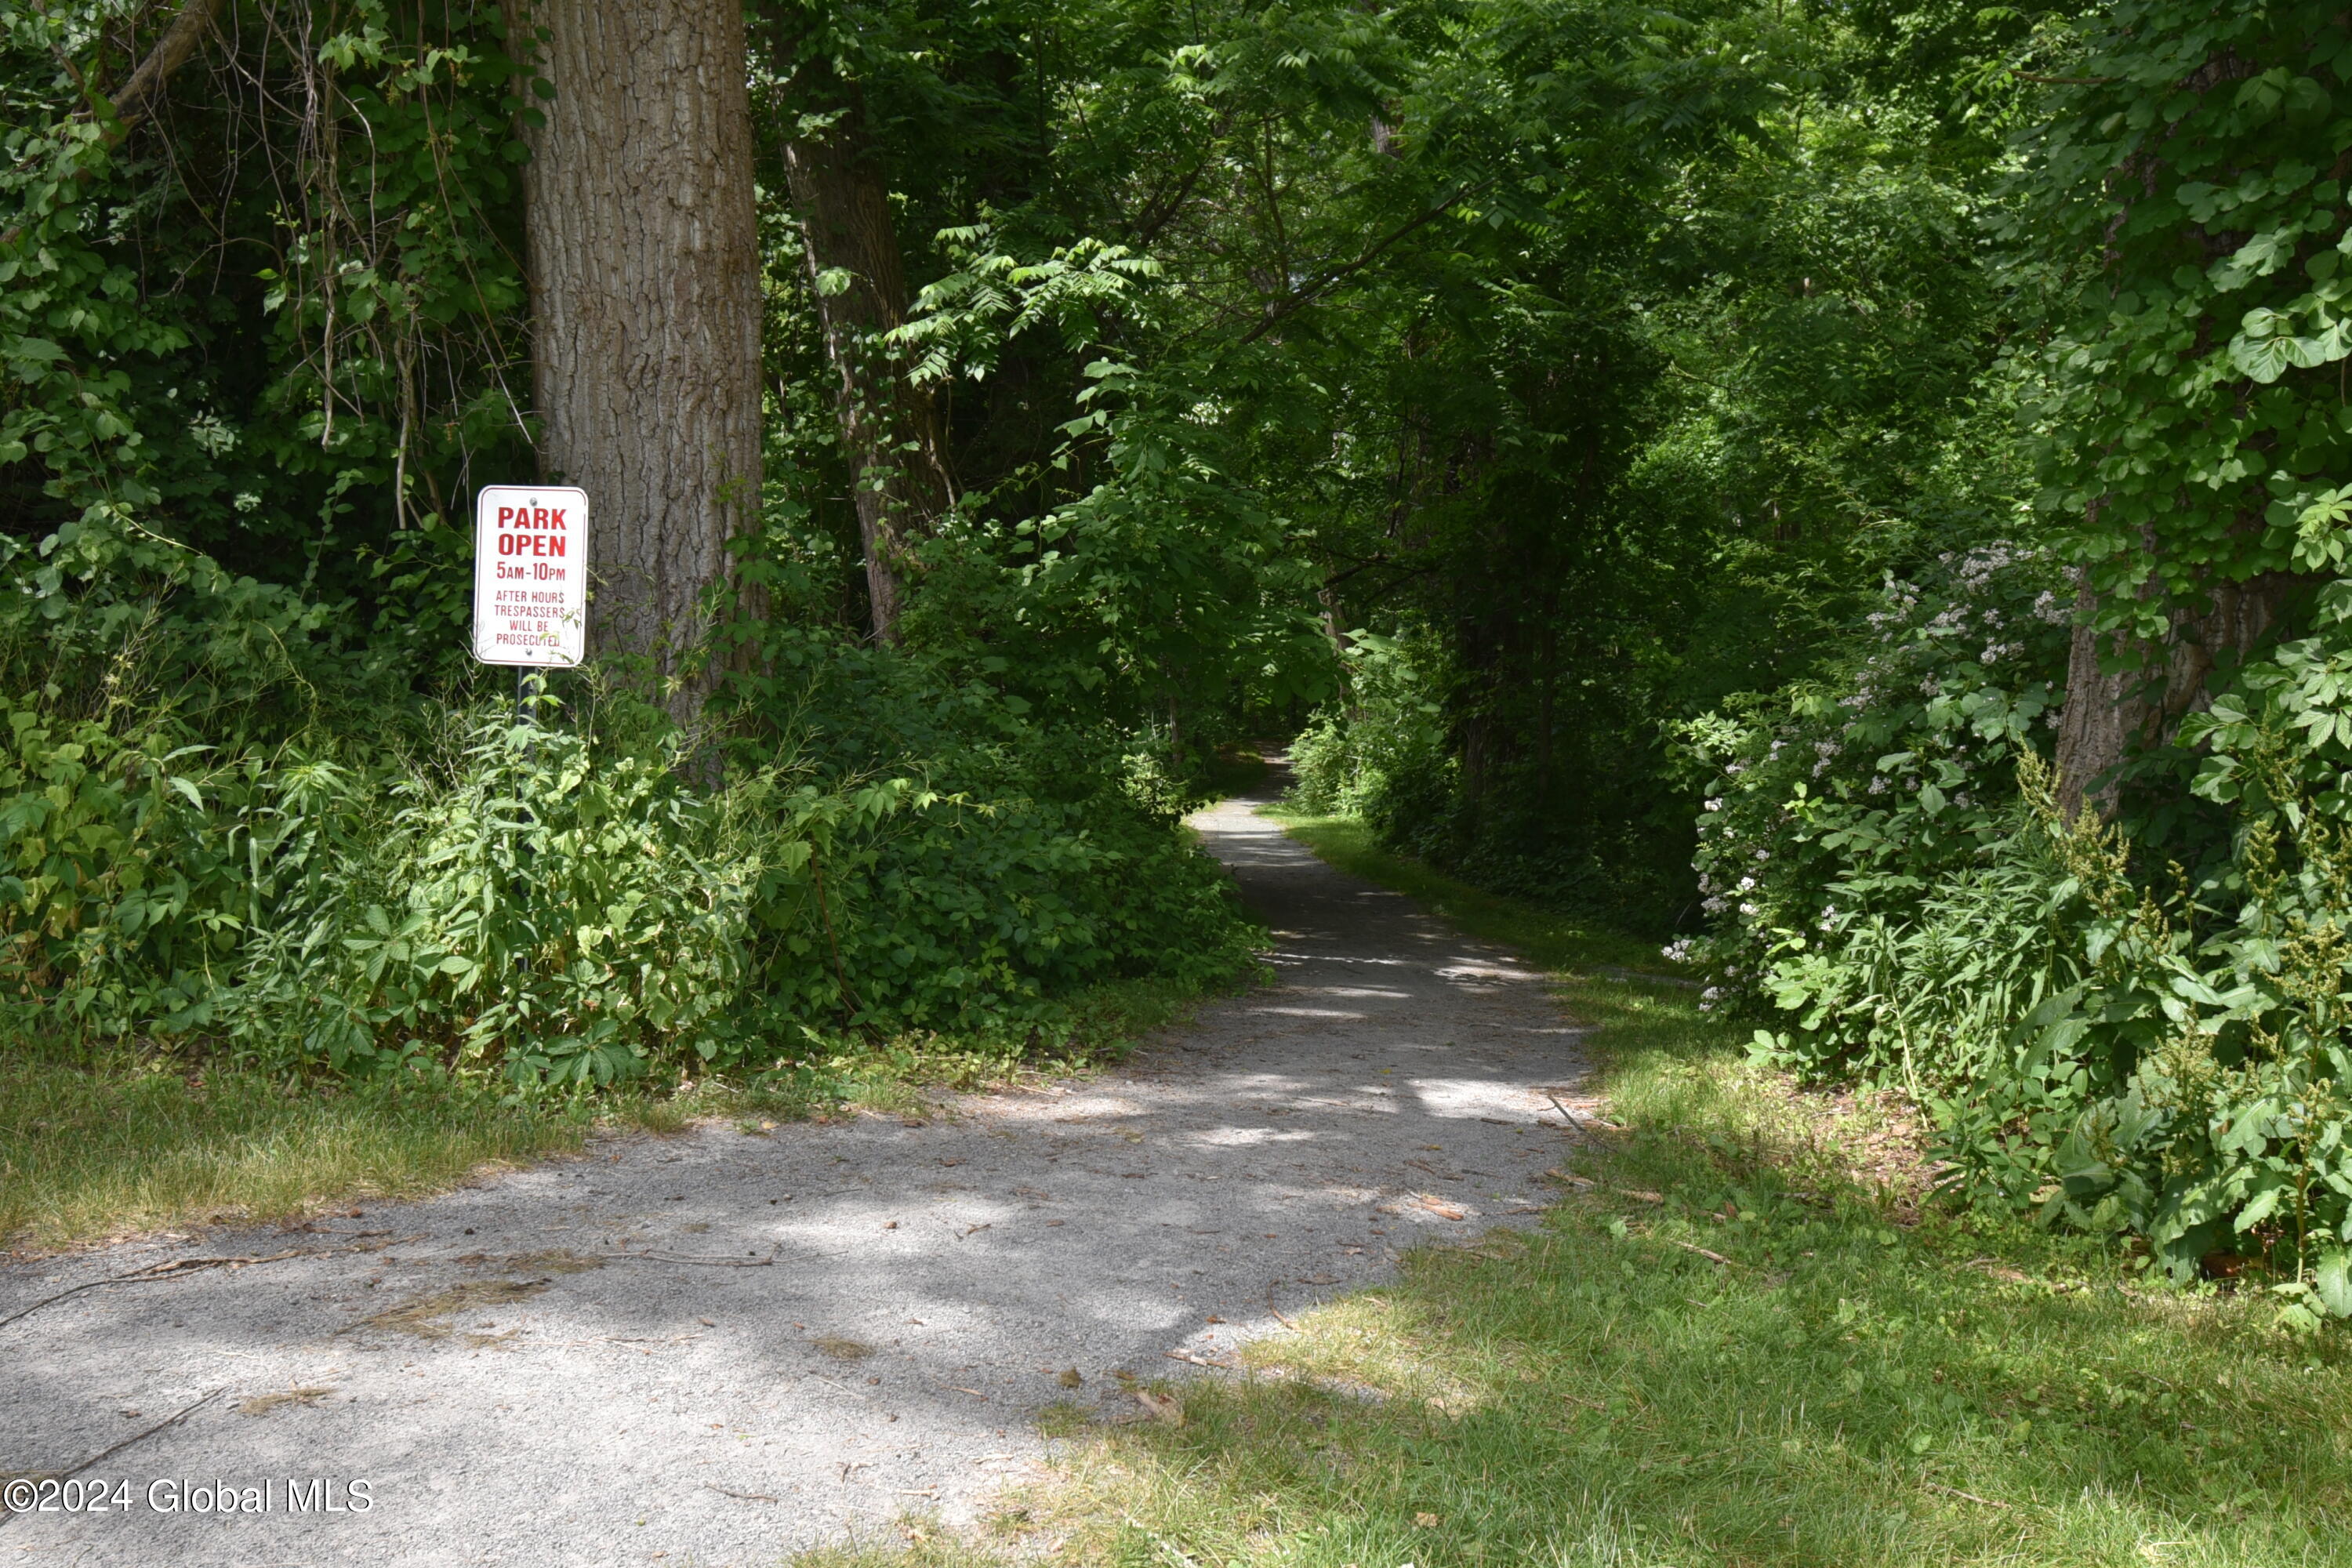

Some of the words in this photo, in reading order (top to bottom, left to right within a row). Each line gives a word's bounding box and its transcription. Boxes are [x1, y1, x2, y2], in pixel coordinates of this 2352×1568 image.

[498, 507, 567, 530] PARK
[498, 533, 566, 557] OPEN
[495, 590, 527, 602] AFTER
[532, 591, 564, 604] HOURS
[494, 604, 564, 619] TRESPASSERS
[510, 620, 532, 632] WILL
[537, 621, 549, 632] BE
